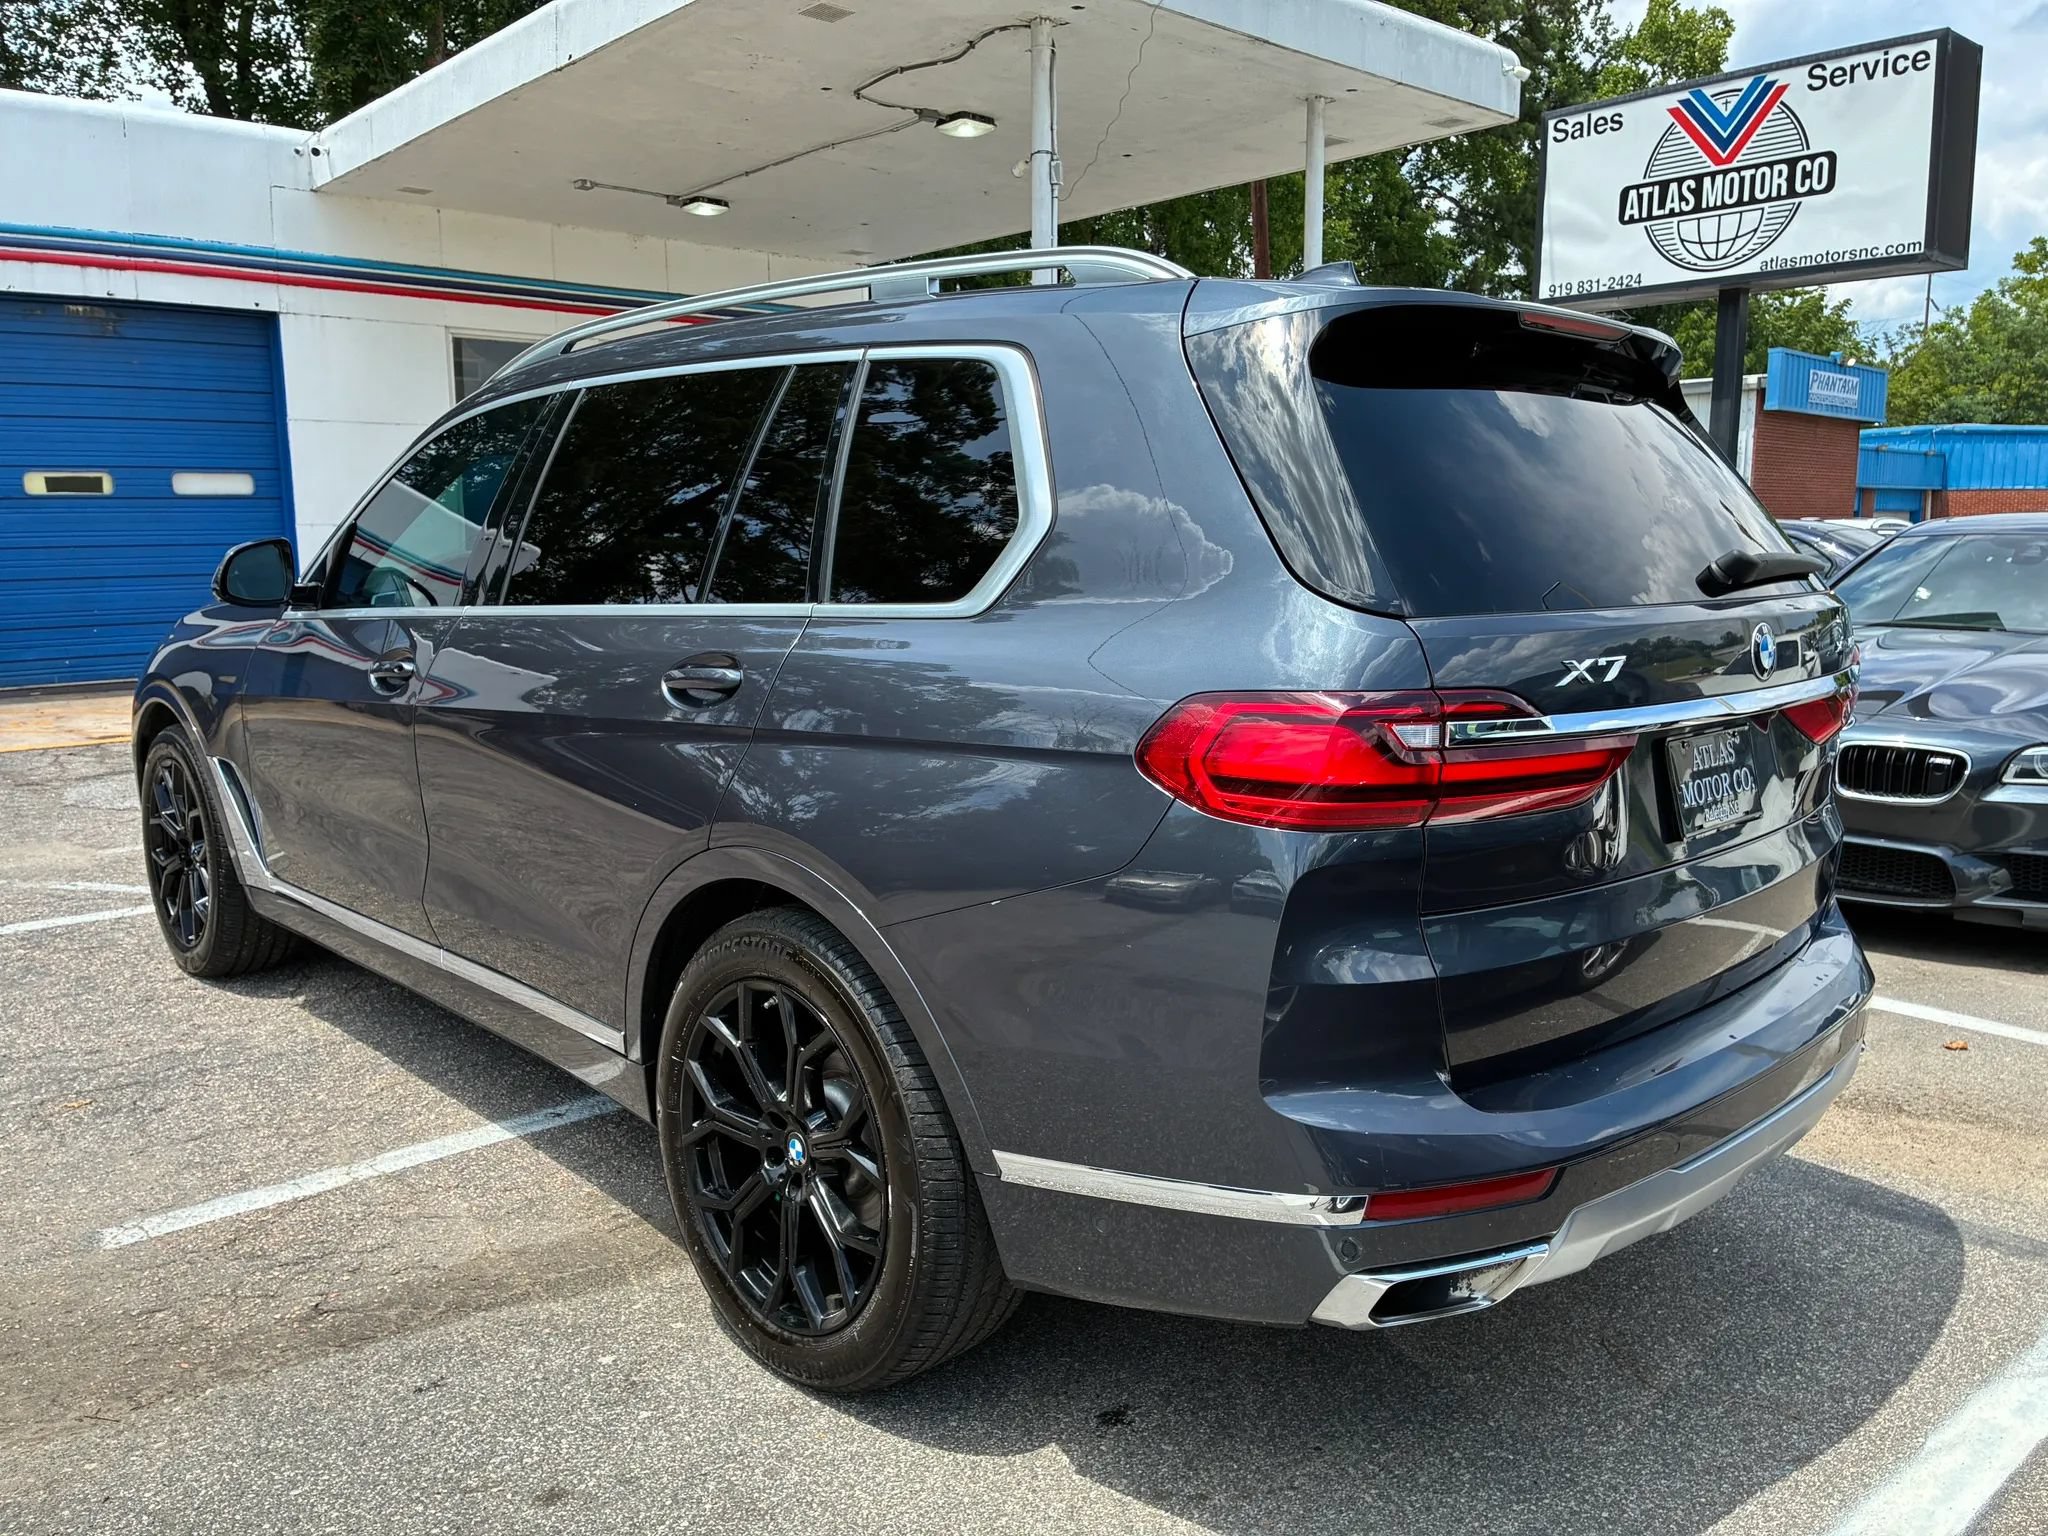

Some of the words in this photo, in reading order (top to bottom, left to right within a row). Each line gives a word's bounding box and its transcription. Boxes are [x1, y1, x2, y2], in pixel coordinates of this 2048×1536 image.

[1807, 50, 1931, 92] Service
[1552, 112, 1624, 143] Sales
[1624, 179, 1697, 222] ATLAS
[1701, 163, 1788, 209] MOTOR
[1794, 156, 1830, 194] CO
[1760, 240, 1922, 272] atlasmotorsnc.com
[1548, 282, 1573, 298] 919
[1577, 273, 1642, 294] 831-2424
[1809, 371, 1859, 396] PHANTASM
[1554, 656, 1627, 687] X7
[1693, 740, 1736, 771] ATLAS
[1680, 773, 1733, 808] MOTOR
